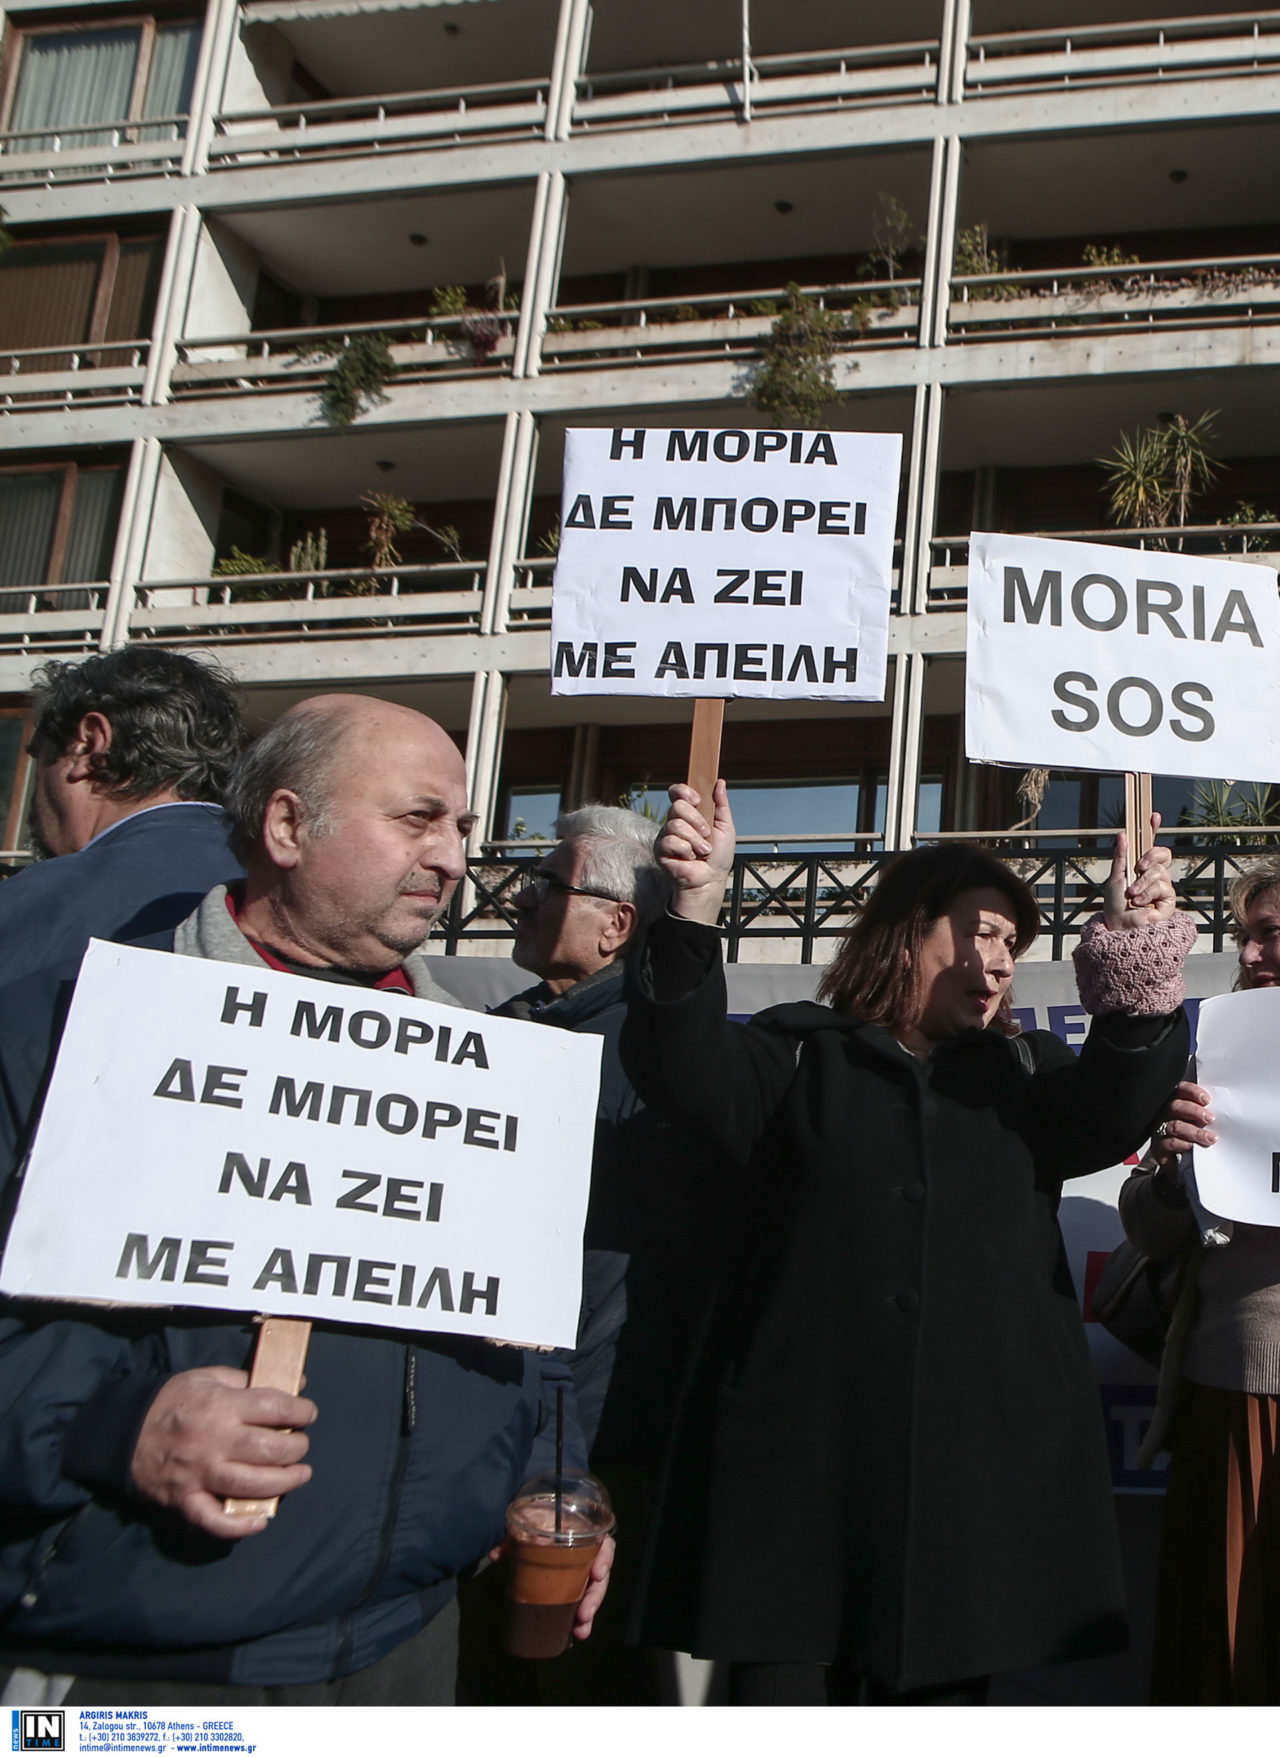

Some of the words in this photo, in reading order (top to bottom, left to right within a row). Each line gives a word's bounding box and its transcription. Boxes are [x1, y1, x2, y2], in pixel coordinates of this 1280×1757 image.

[609, 428, 645, 461] Η
[666, 430, 839, 466] ΜΟΡΙΑ
[564, 495, 635, 530] ΔΕ
[653, 497, 867, 535] ΜΠΟΡΕΙ
[621, 567, 694, 603] ΝΑ
[714, 569, 803, 606] ΖΕΙ
[1004, 567, 1265, 648] MORIA
[553, 642, 636, 679] ΜΕ
[655, 642, 857, 683] ΑΠΕΙΛΗ
[1051, 671, 1214, 741] SOS
[221, 986, 268, 1027] Η
[290, 1000, 490, 1070] ΜΟΡΙΑ
[153, 1058, 248, 1109] ΔΕ
[269, 1076, 518, 1152] ΜΠΟΡΕΙ
[218, 1152, 312, 1205] ΝΑ
[336, 1170, 443, 1222] ΖΕΙ
[116, 1233, 234, 1286] ΜΕ
[252, 1248, 500, 1317] ΑΠΕΙΛΗ
